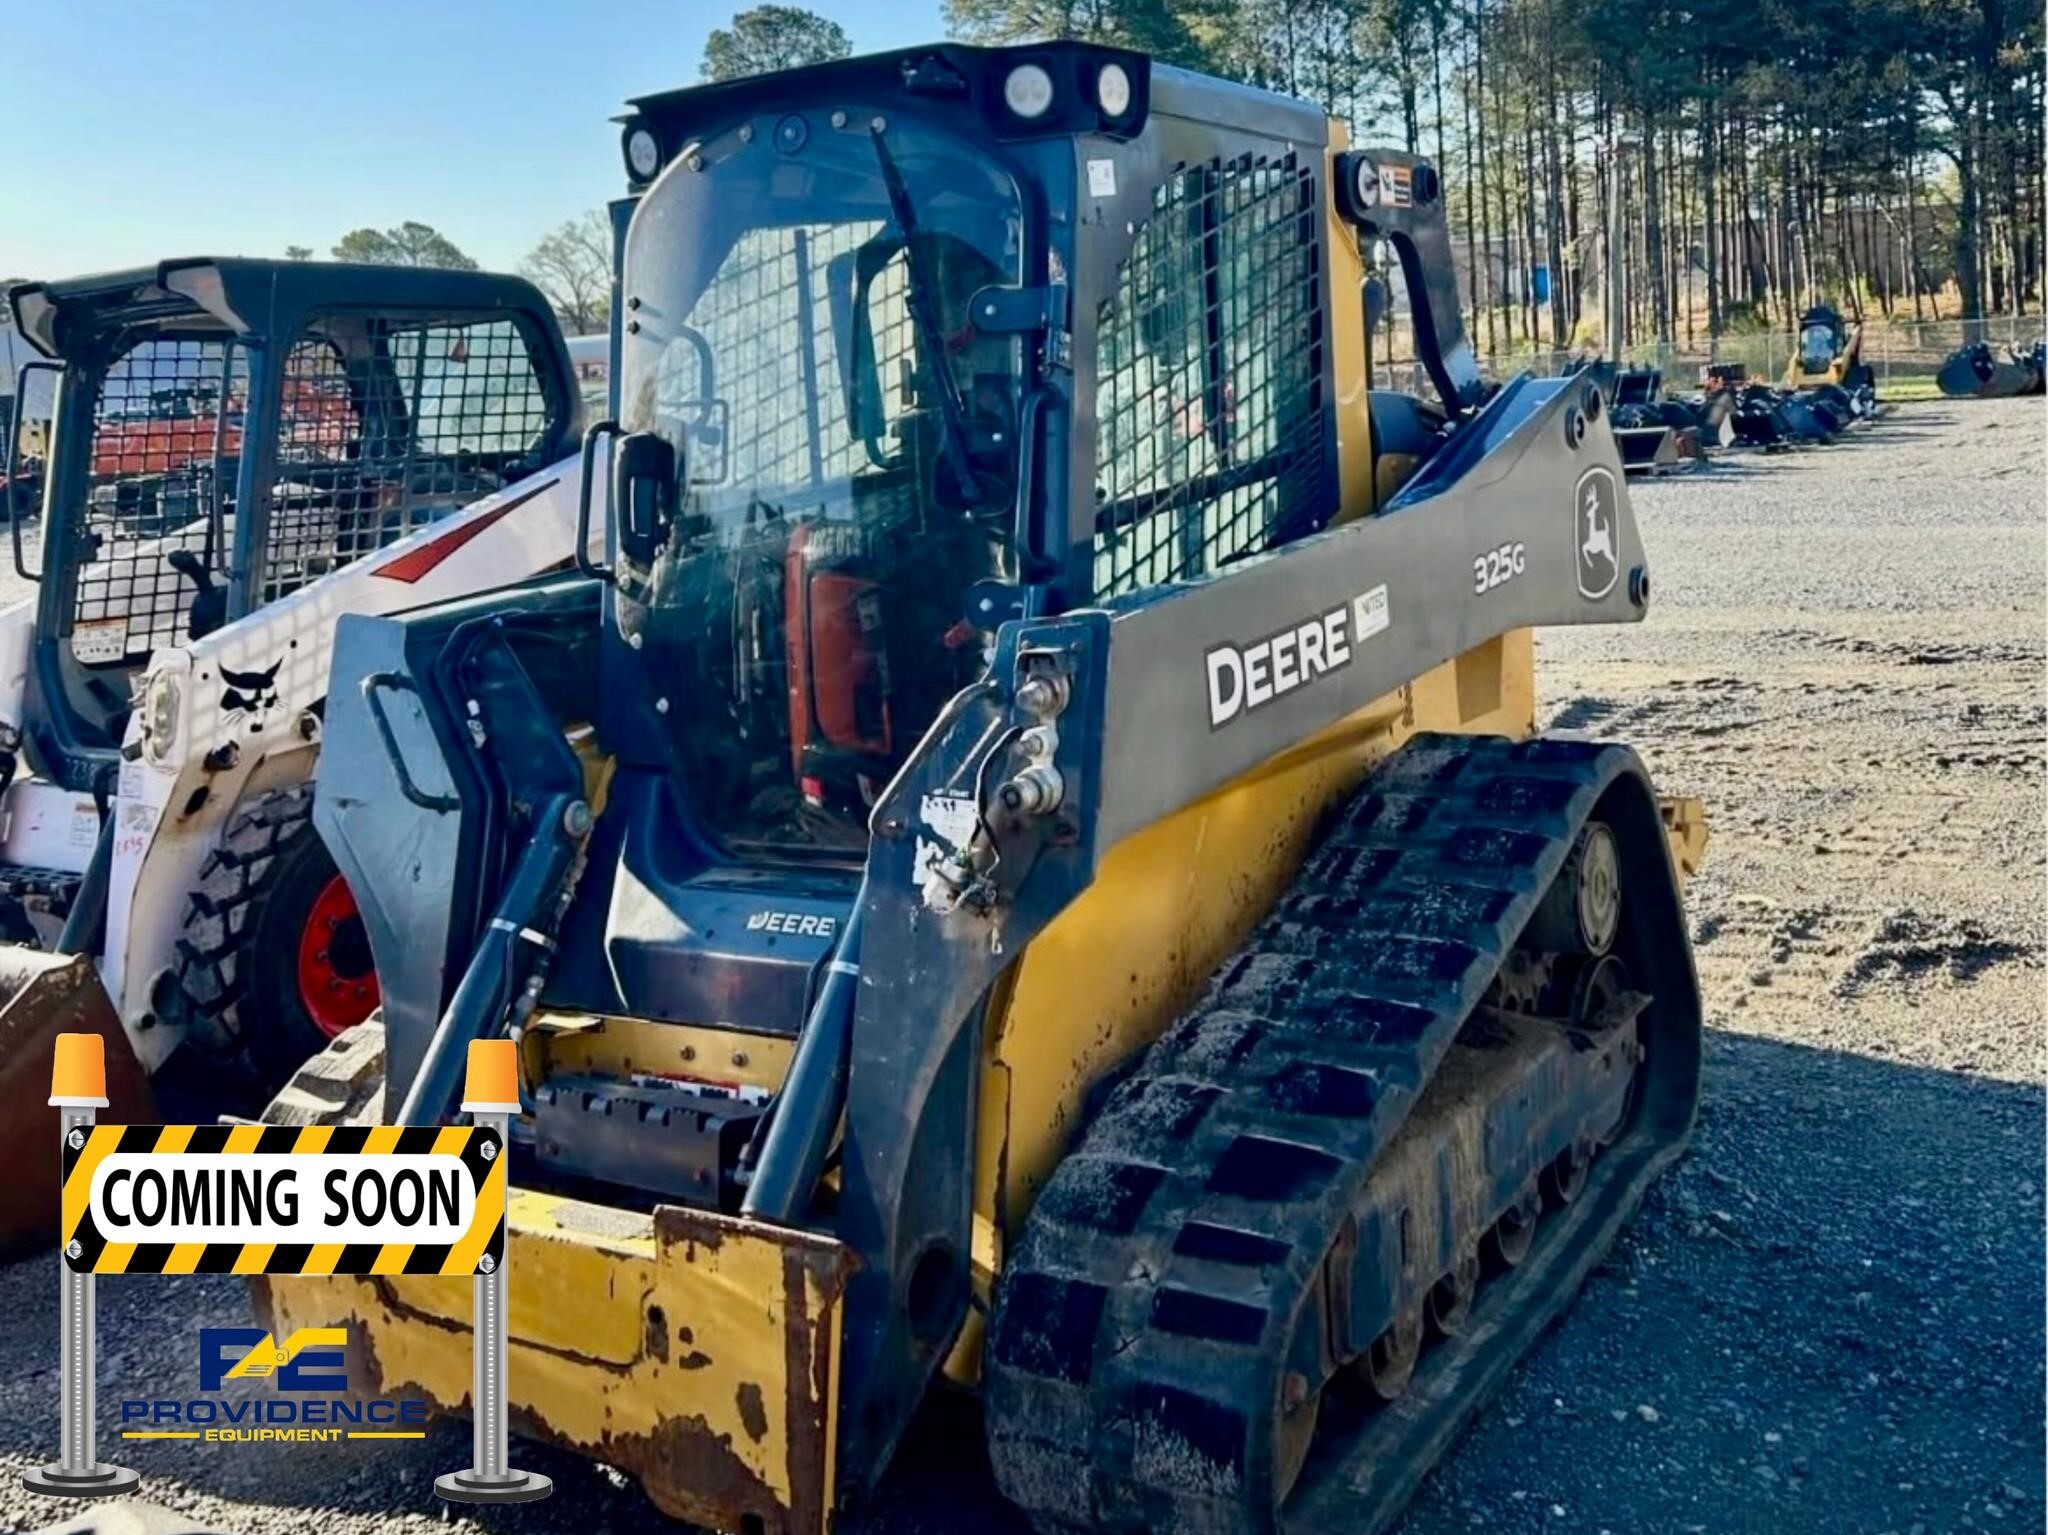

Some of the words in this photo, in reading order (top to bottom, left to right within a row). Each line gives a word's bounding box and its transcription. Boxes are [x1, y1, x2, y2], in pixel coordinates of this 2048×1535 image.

[1473, 543, 1526, 595] 325G
[1206, 606, 1351, 727] DEERE
[746, 910, 836, 937] DEERE
